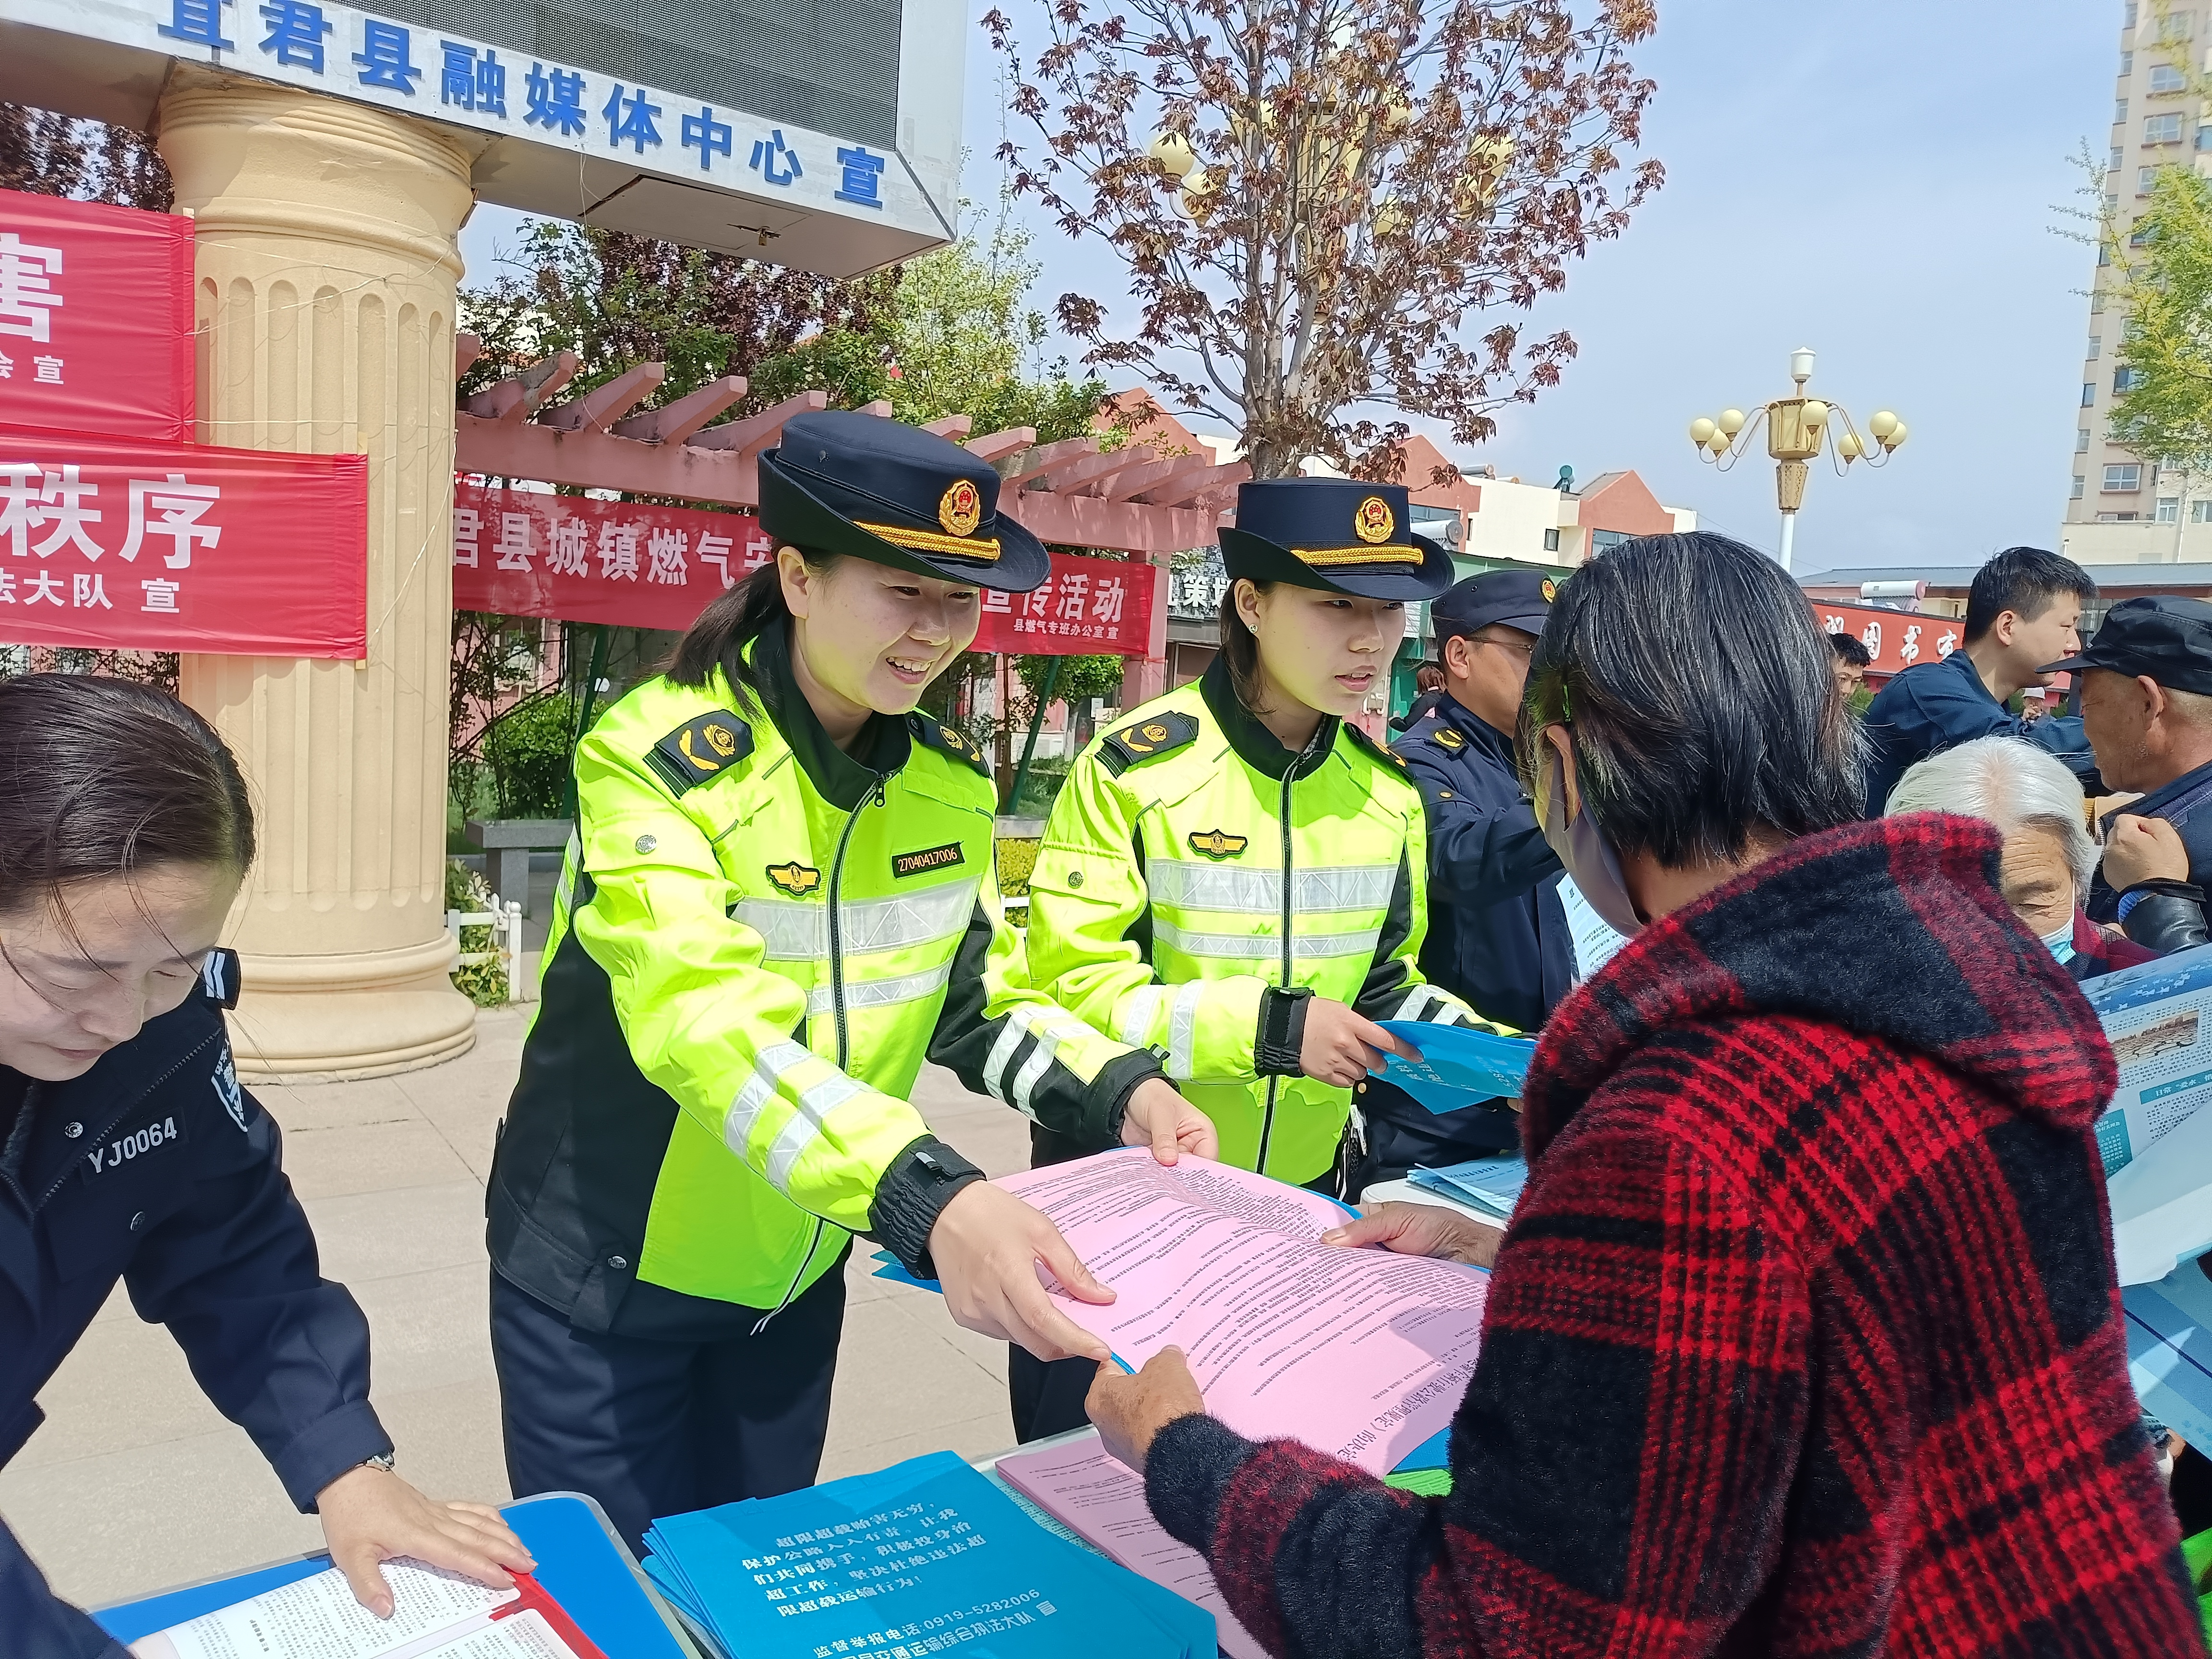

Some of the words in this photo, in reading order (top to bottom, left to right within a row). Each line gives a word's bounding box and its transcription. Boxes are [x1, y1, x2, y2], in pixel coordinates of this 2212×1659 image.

[834, 146, 885, 210] 宣
[33, 355, 64, 385] 宣
[0, 462, 222, 569] 秩序
[141, 577, 180, 613] 宣
[898, 847, 958, 872] 27040417006
[88, 1117, 178, 1174] YJ0064
